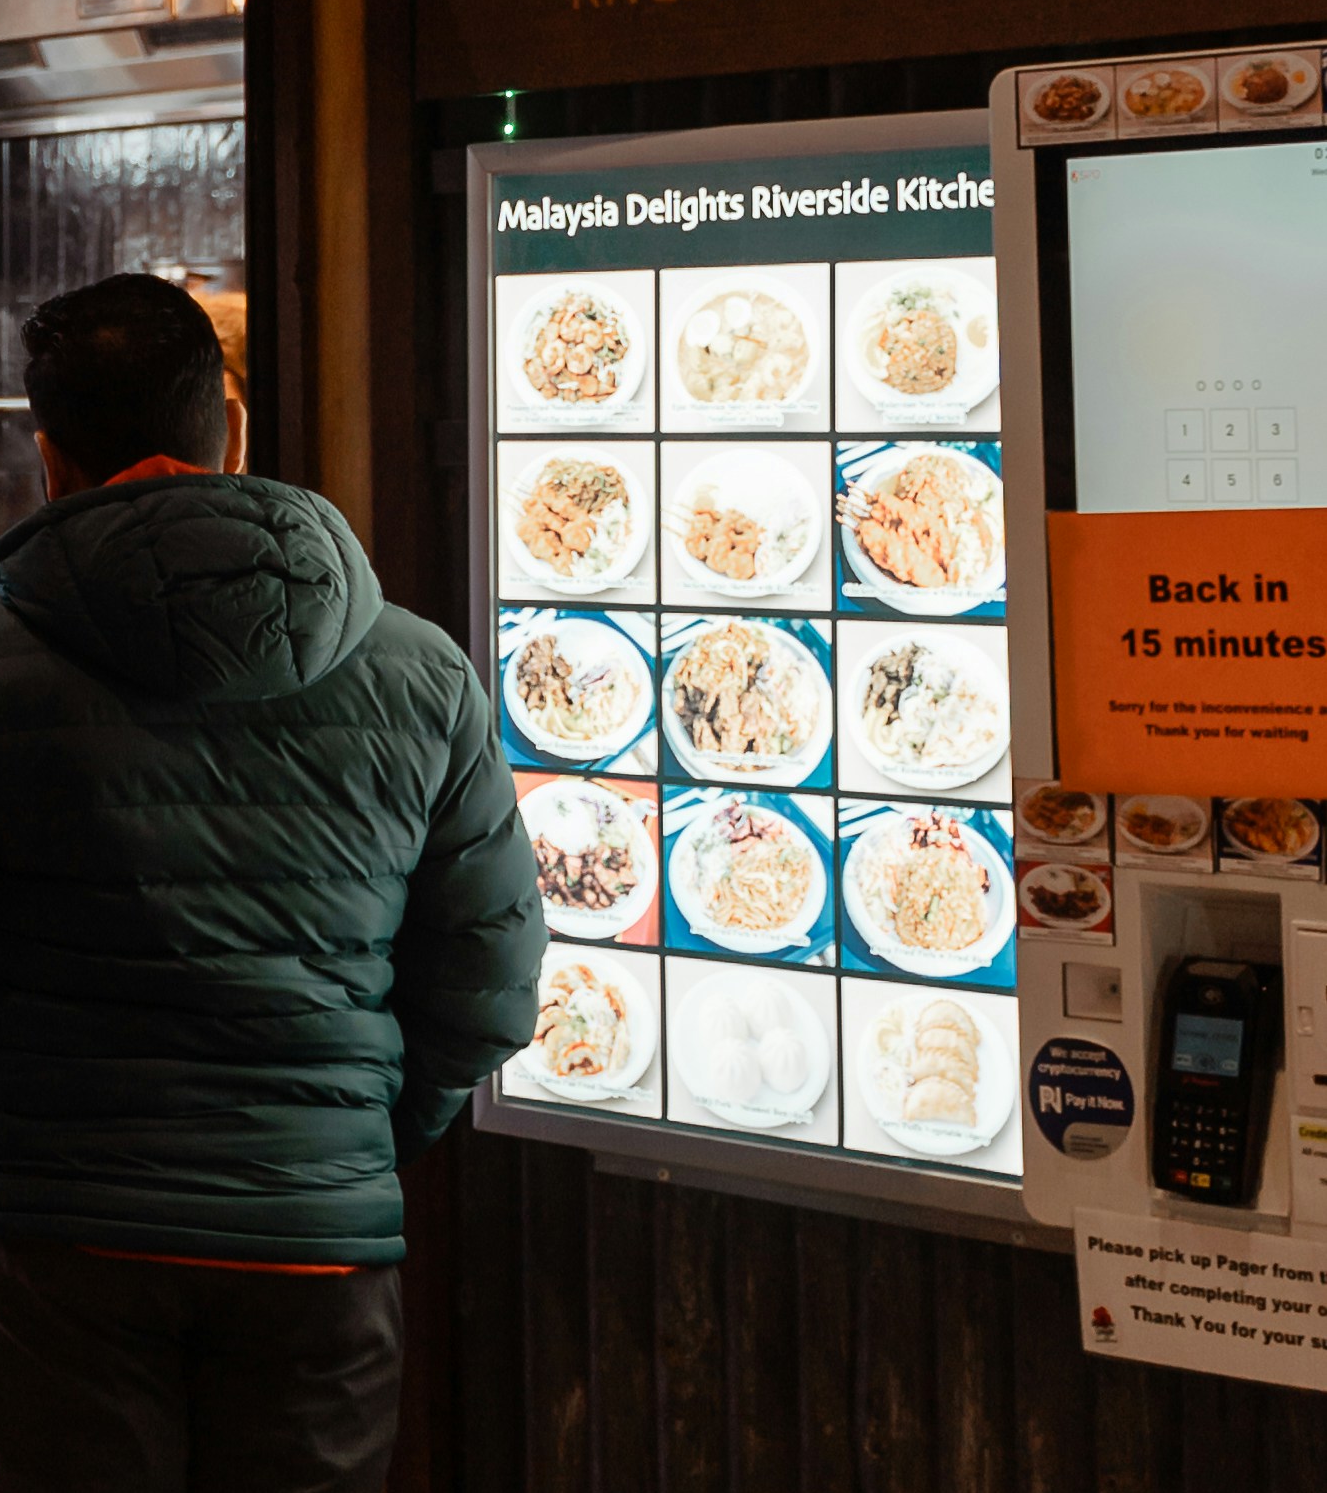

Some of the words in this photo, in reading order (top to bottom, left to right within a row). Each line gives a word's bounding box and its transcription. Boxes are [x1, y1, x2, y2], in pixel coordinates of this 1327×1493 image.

[497, 196, 619, 236] Malaysia
[626, 187, 745, 231] Delights
[752, 178, 889, 219] Riverside
[897, 172, 995, 211] Kitche
[1182, 424, 1187, 436] 1
[1225, 423, 1235, 437] 2
[1271, 423, 1280, 436] 3
[1181, 474, 1191, 486] 4
[1227, 473, 1236, 486] 5
[1273, 473, 1282, 486] 6
[1149, 574, 1241, 604] Back
[1254, 573, 1289, 603] in
[1121, 628, 1162, 658] 15
[1174, 628, 1327, 659] minutes
[1108, 699, 1145, 716] Sorry
[1149, 700, 1169, 713] for
[1173, 701, 1196, 714] the
[1201, 702, 1314, 716] inconvenience
[1145, 723, 1189, 738] Thank
[1193, 726, 1220, 741] you
[1224, 725, 1246, 739] for
[1250, 726, 1309, 743] waiting
[1088, 1236, 1144, 1258] Please
[1149, 1246, 1185, 1264] pick
[1190, 1254, 1211, 1269] up
[1217, 1255, 1268, 1277] Pager
[1272, 1262, 1314, 1283] from
[1125, 1274, 1165, 1292] after
[1169, 1281, 1267, 1311] completing
[1272, 1297, 1313, 1314] your
[1131, 1305, 1186, 1329] Thank
[1191, 1315, 1226, 1335] You
[1231, 1321, 1258, 1340] for
[1262, 1328, 1305, 1347] your
